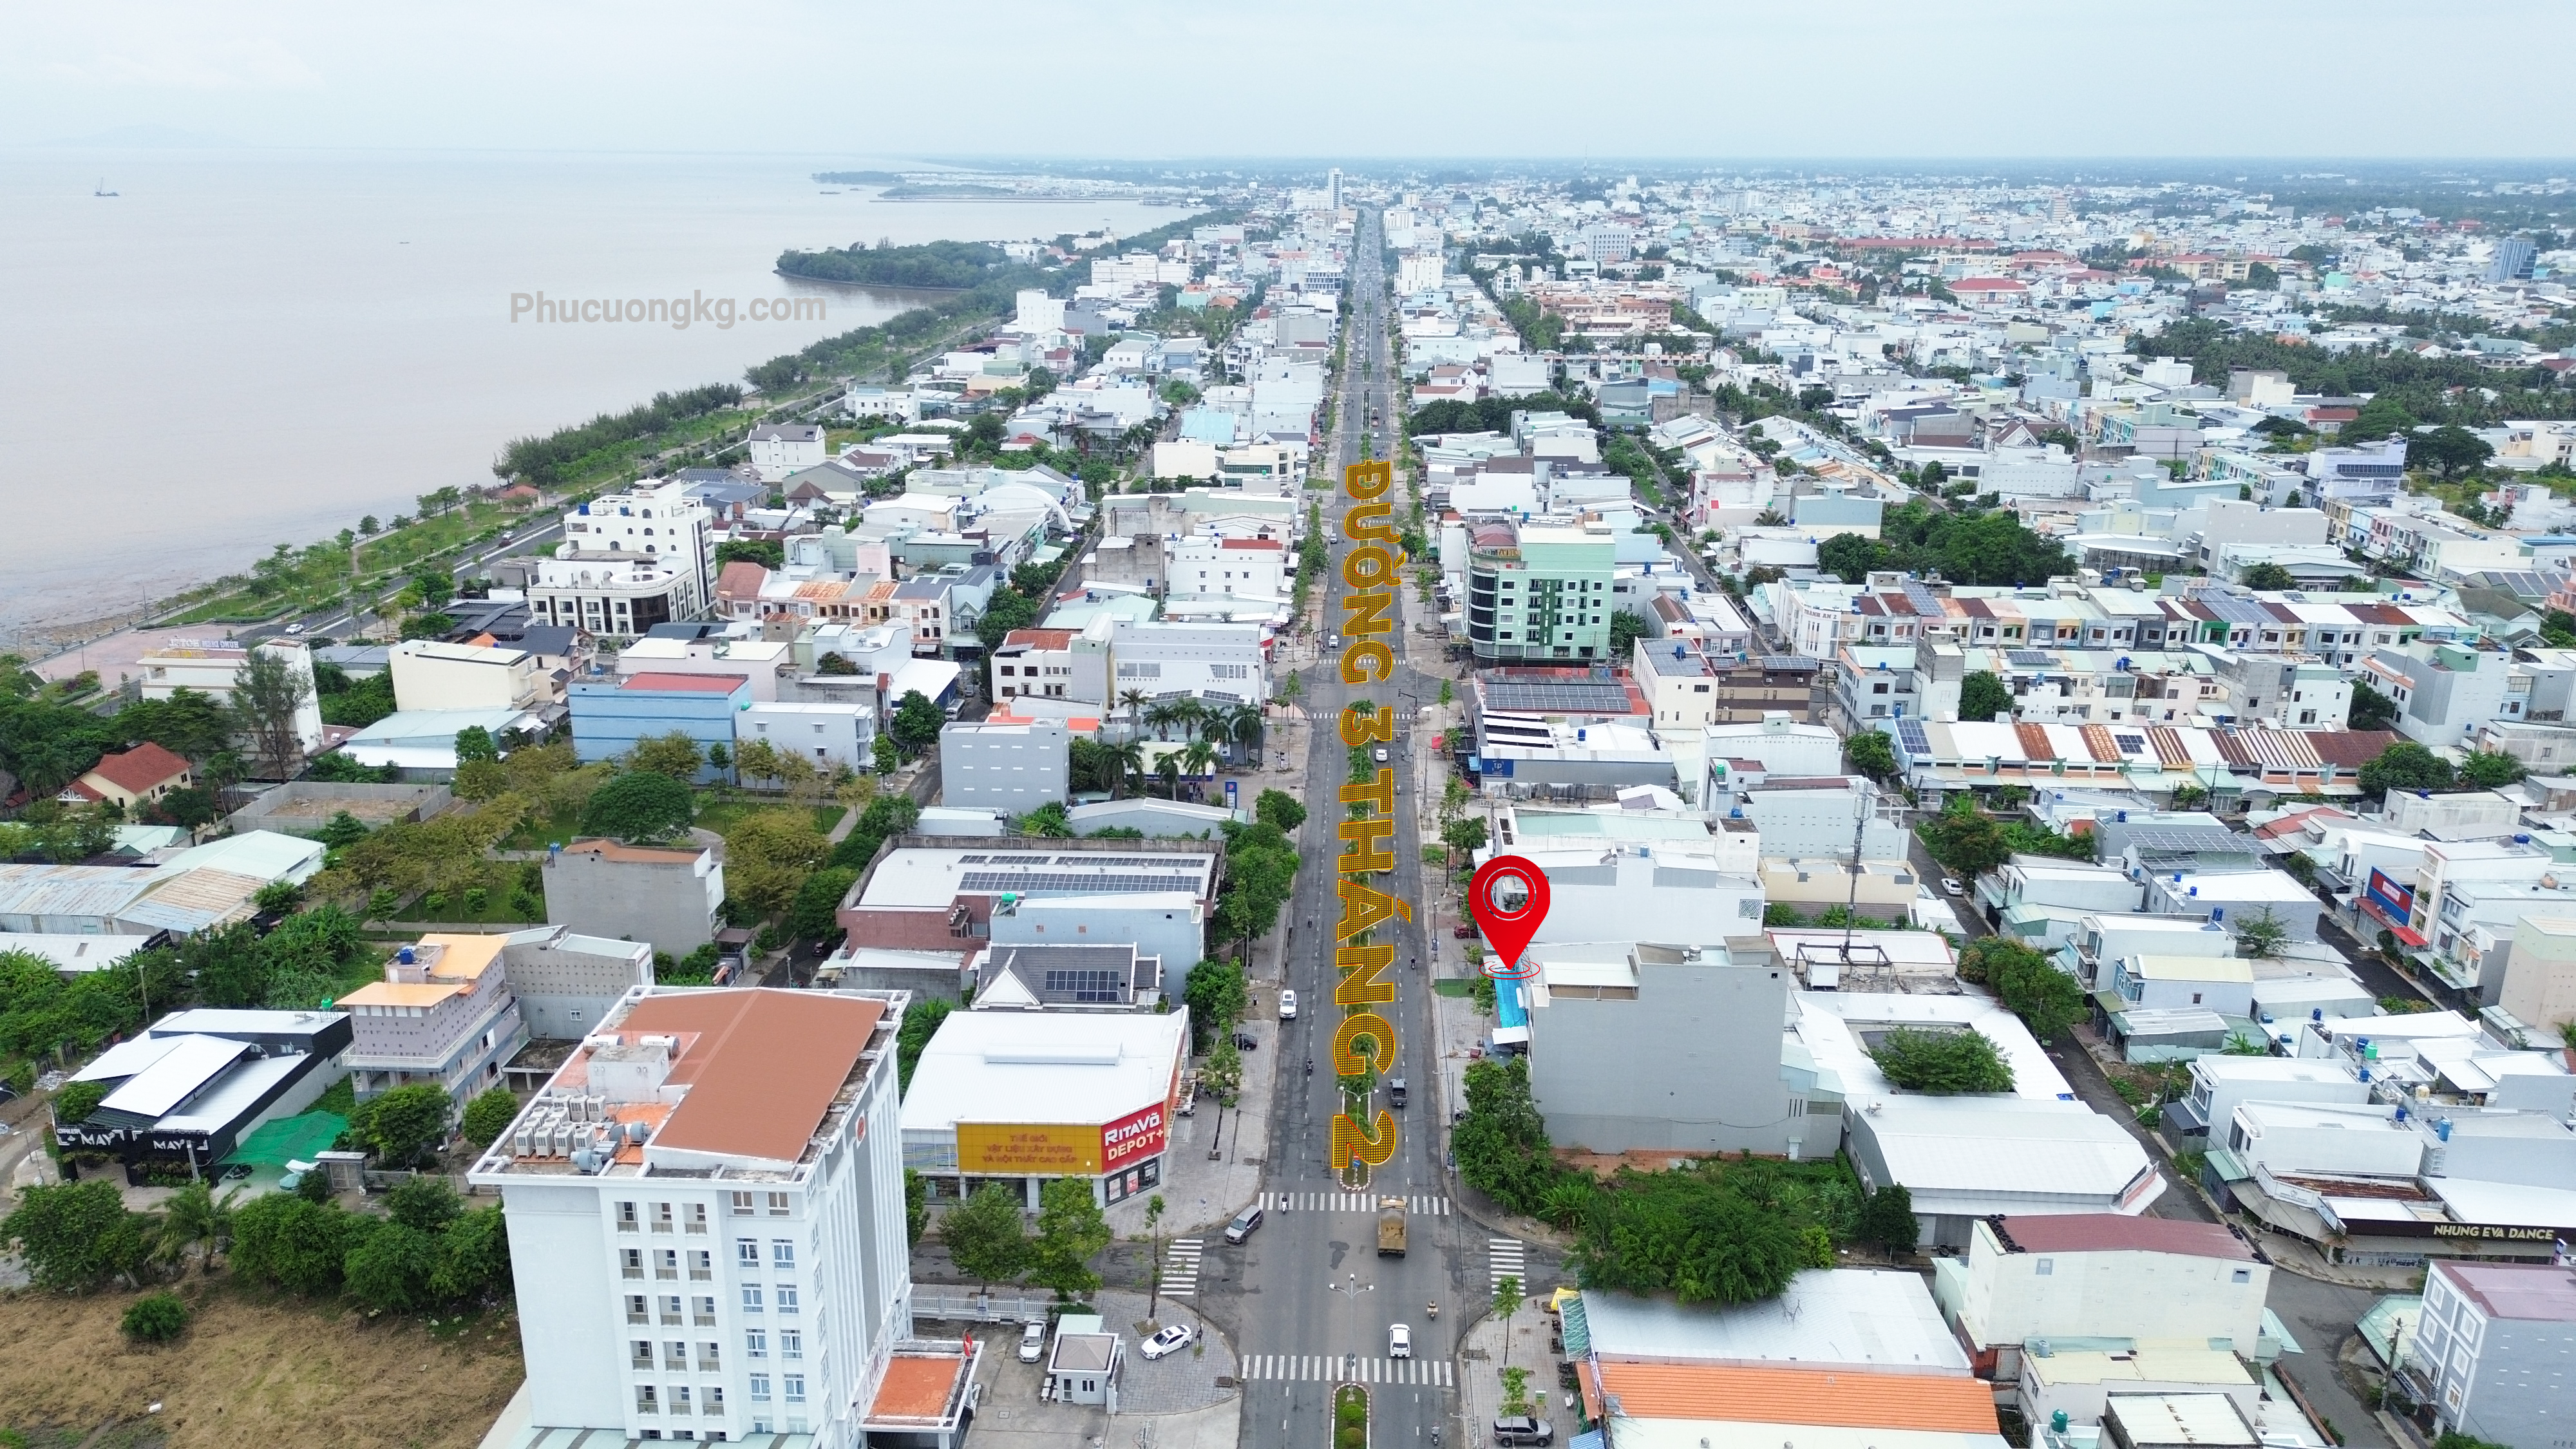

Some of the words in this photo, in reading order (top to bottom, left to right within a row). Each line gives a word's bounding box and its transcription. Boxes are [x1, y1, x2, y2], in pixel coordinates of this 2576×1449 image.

[2433, 1224, 2479, 1237] NHUNG
[2482, 1226, 2505, 1238] EVA
[2508, 1227, 2555, 1240] DANCE
